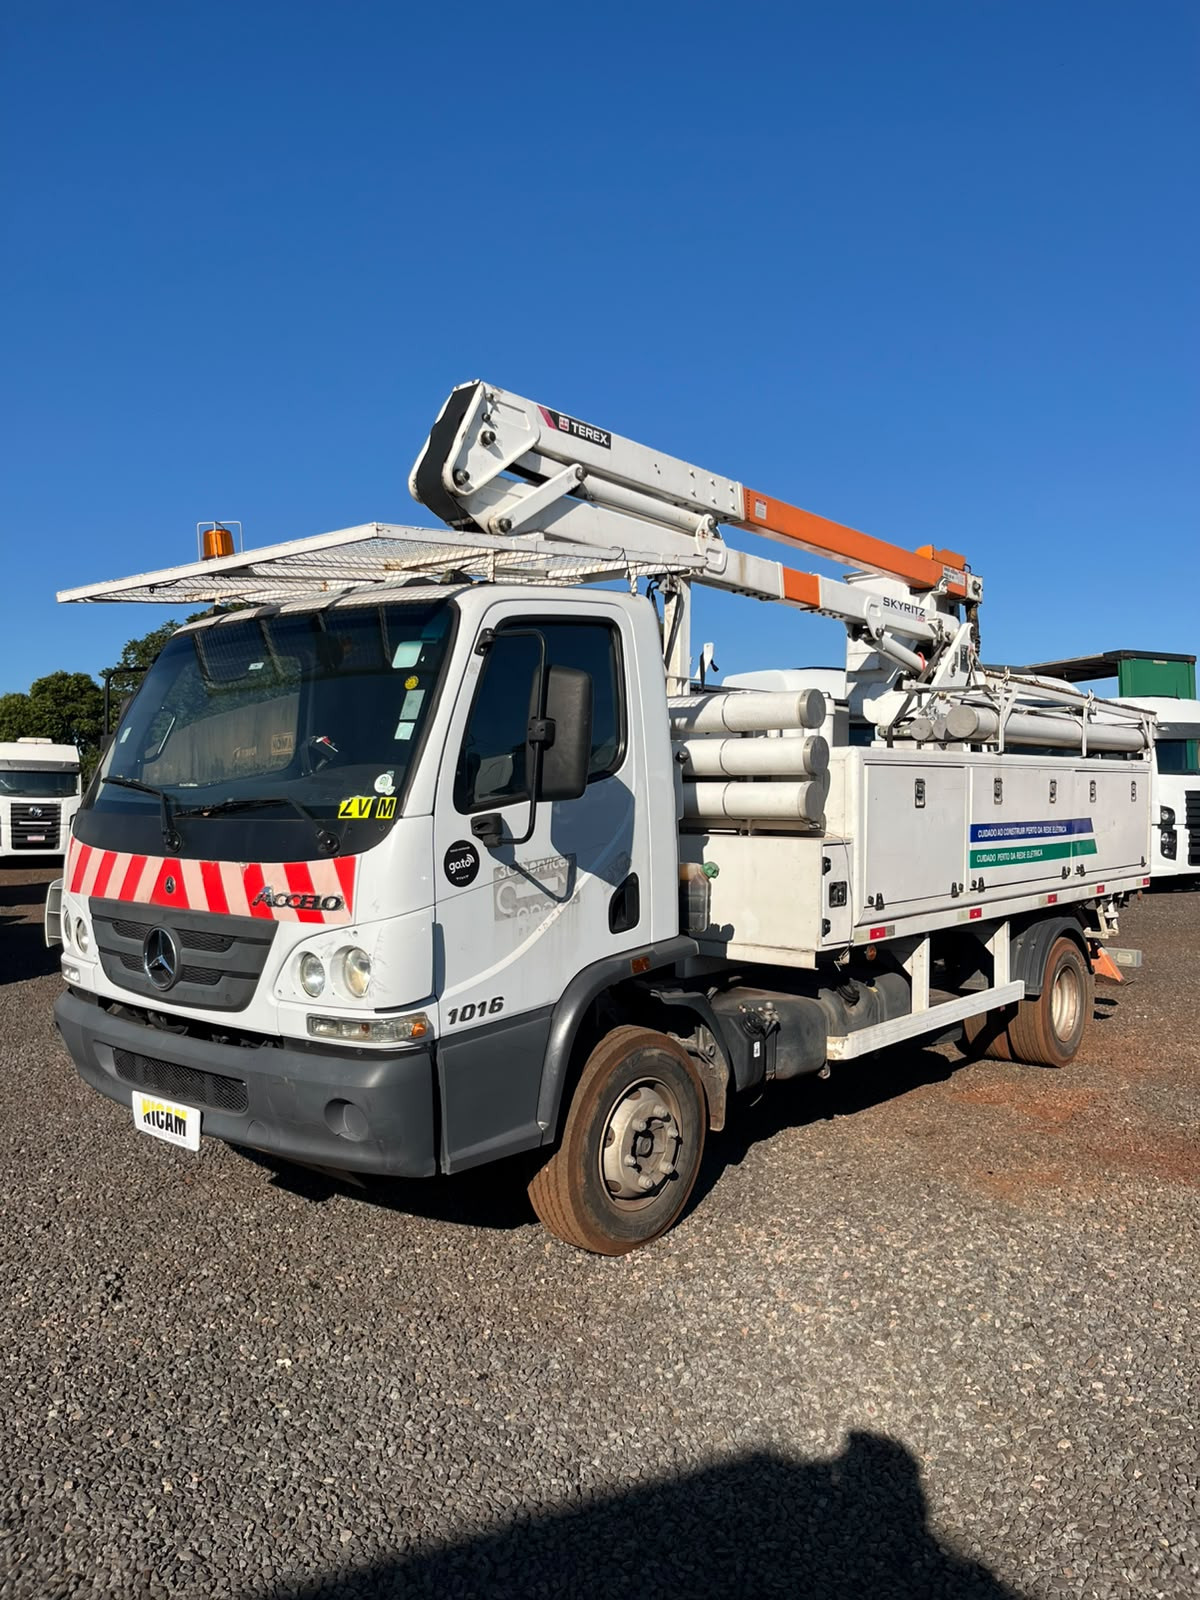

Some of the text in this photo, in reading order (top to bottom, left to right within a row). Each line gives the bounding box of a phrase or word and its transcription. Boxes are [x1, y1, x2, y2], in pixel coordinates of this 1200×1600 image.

[571, 421, 608, 446] TEREX
[883, 596, 926, 617] SKYRITZ
[977, 829, 997, 839] CUIDADO
[997, 828, 1003, 837] AO
[1004, 827, 1026, 836] CONSTRUIR
[1026, 826, 1038, 835] PERTO
[1043, 825, 1052, 833] REDE
[976, 854, 996, 863] CUIDADO
[997, 852, 1010, 861] PERTO
[1010, 852, 1016, 861] DA
[1016, 851, 1026, 860] REDE
[448, 996, 505, 1025] 1016
[142, 1098, 187, 1137] NICAM
